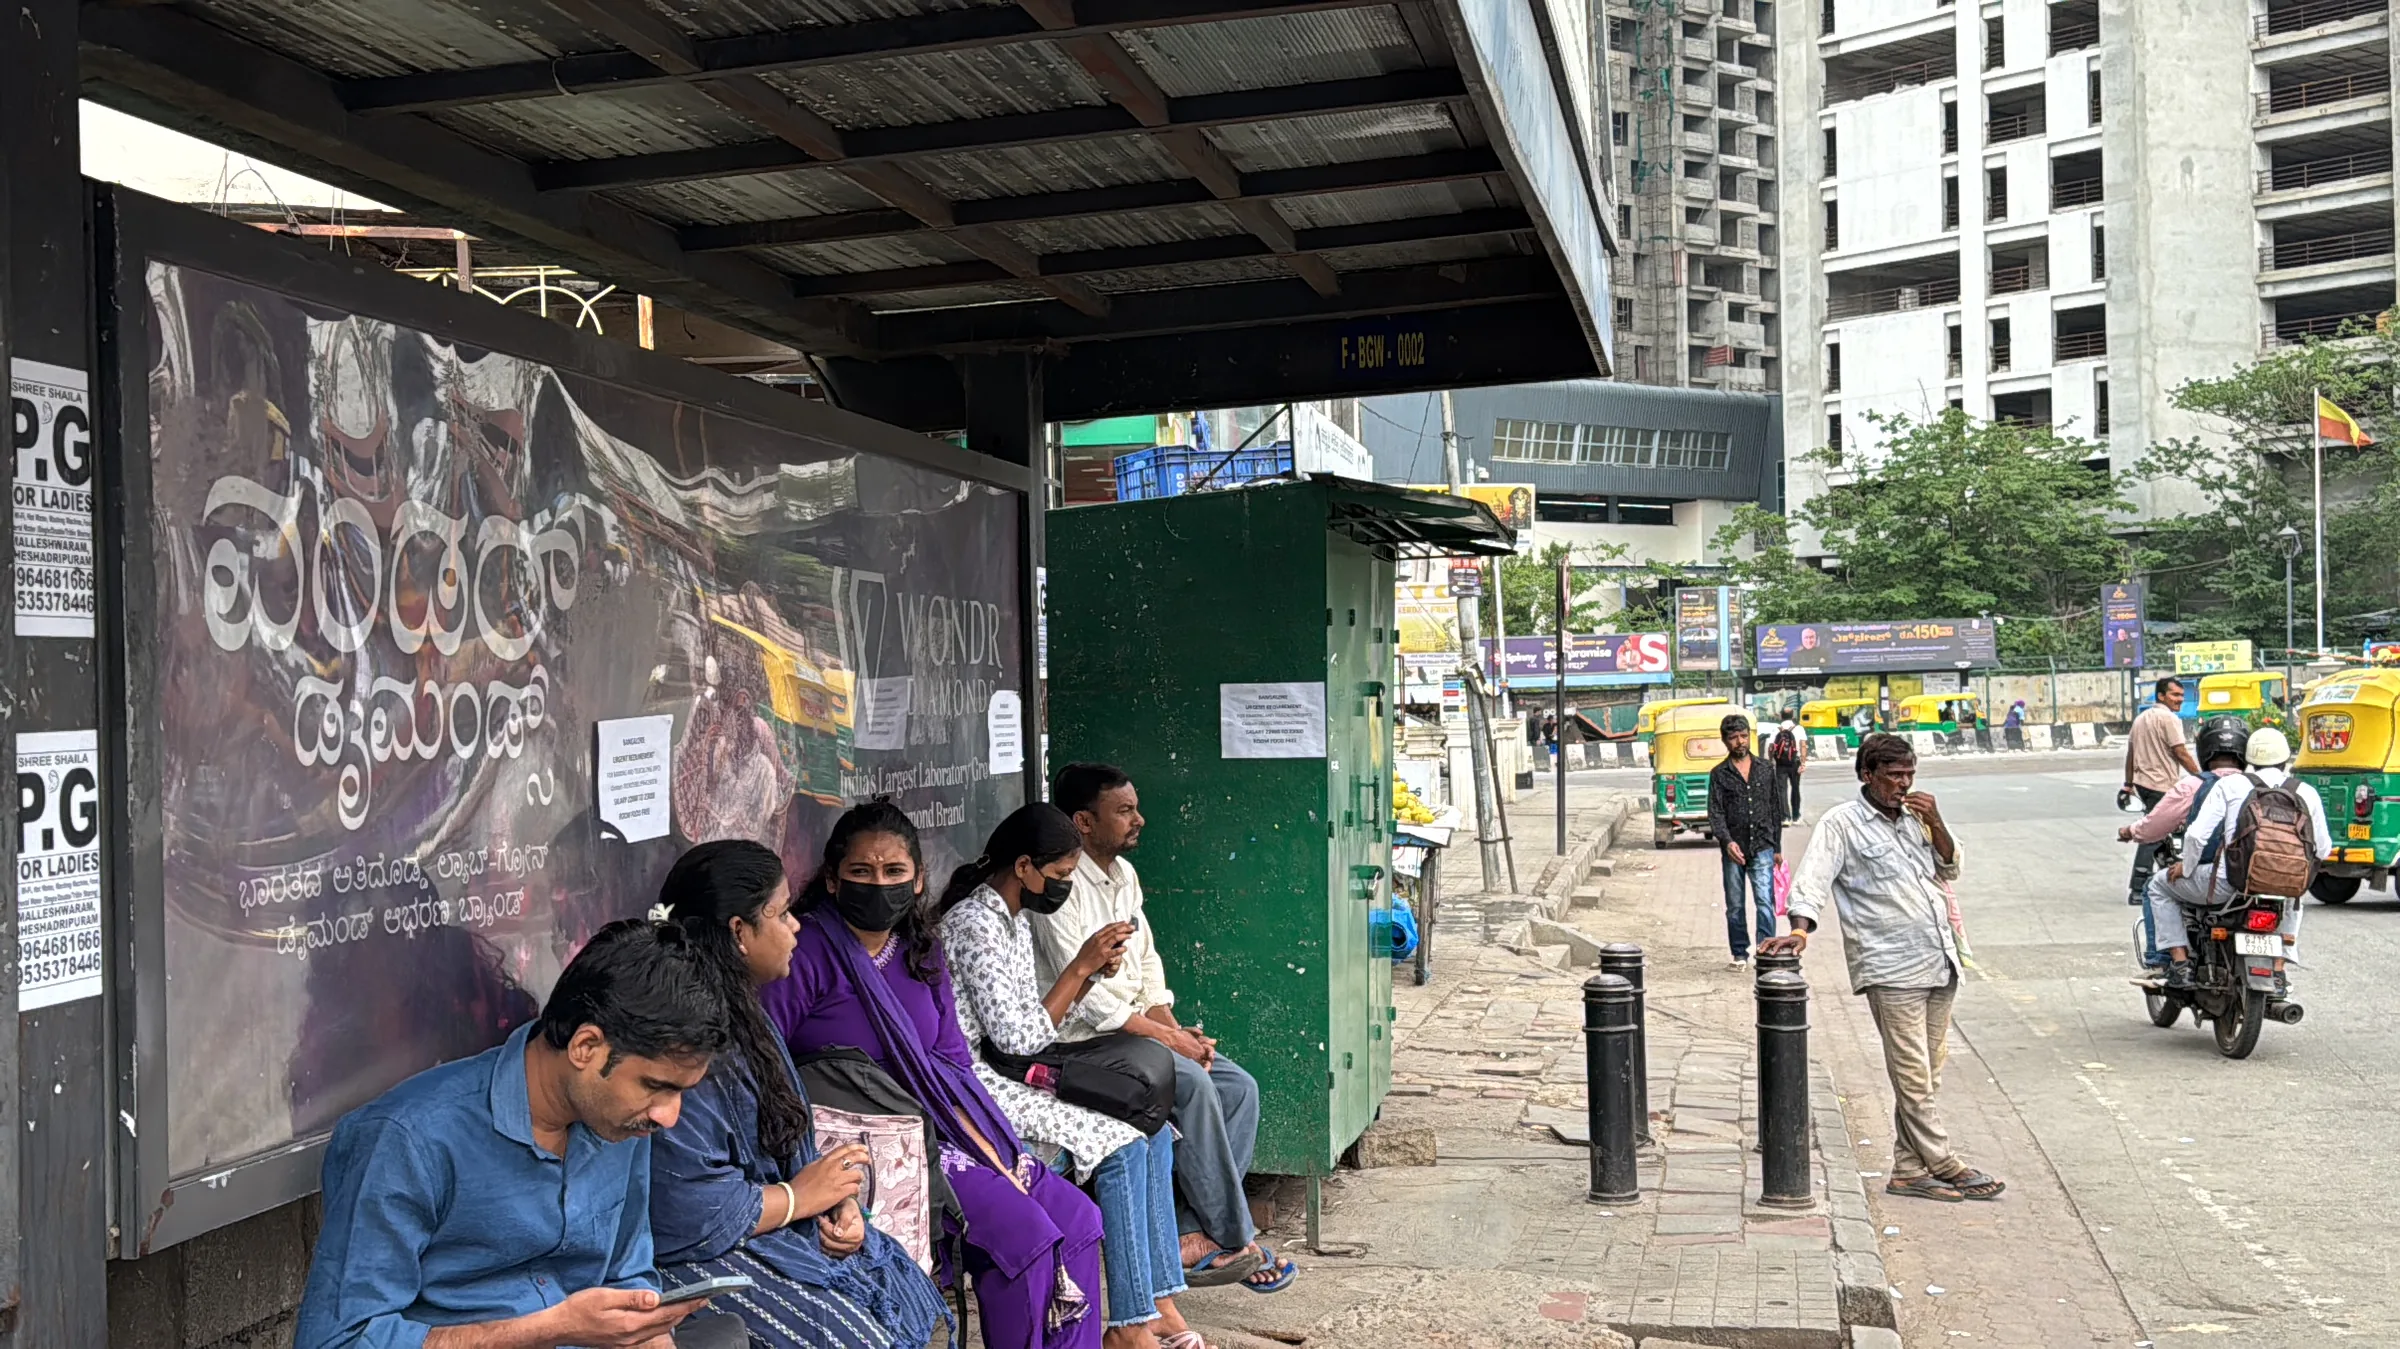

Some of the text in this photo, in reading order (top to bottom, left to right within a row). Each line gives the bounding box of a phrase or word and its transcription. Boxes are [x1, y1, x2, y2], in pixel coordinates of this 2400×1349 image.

[1358, 334, 1384, 368] BGW
[1398, 332, 1424, 366] 0002
[12, 382, 82, 404] SHREE SHAILA
[14, 486, 92, 512] OR LADIES
[14, 550, 92, 566] HESHADRIPURAM
[202, 474, 586, 662] ವಂಡರ್
[16, 567, 94, 590] 964681666
[16, 590, 94, 613] 535378446
[896, 592, 1003, 669] WONDR
[1506, 652, 1537, 664] Spinny
[18, 754, 88, 768] SHREE SHAILA
[840, 767, 877, 797] India's
[878, 767, 917, 799] Largest
[919, 759, 971, 792] Laboratory
[936, 797, 965, 829] Brand
[18, 852, 99, 880] OR LADIES
[238, 861, 322, 917] ಭಾರತದ
[333, 851, 428, 893] ಅತಿದೊಡ್ಡ
[18, 914, 98, 936] HESHADRIPURAM
[277, 907, 374, 961] ಡೈಮಂಡ್
[384, 895, 450, 939] ಆಭರಣ
